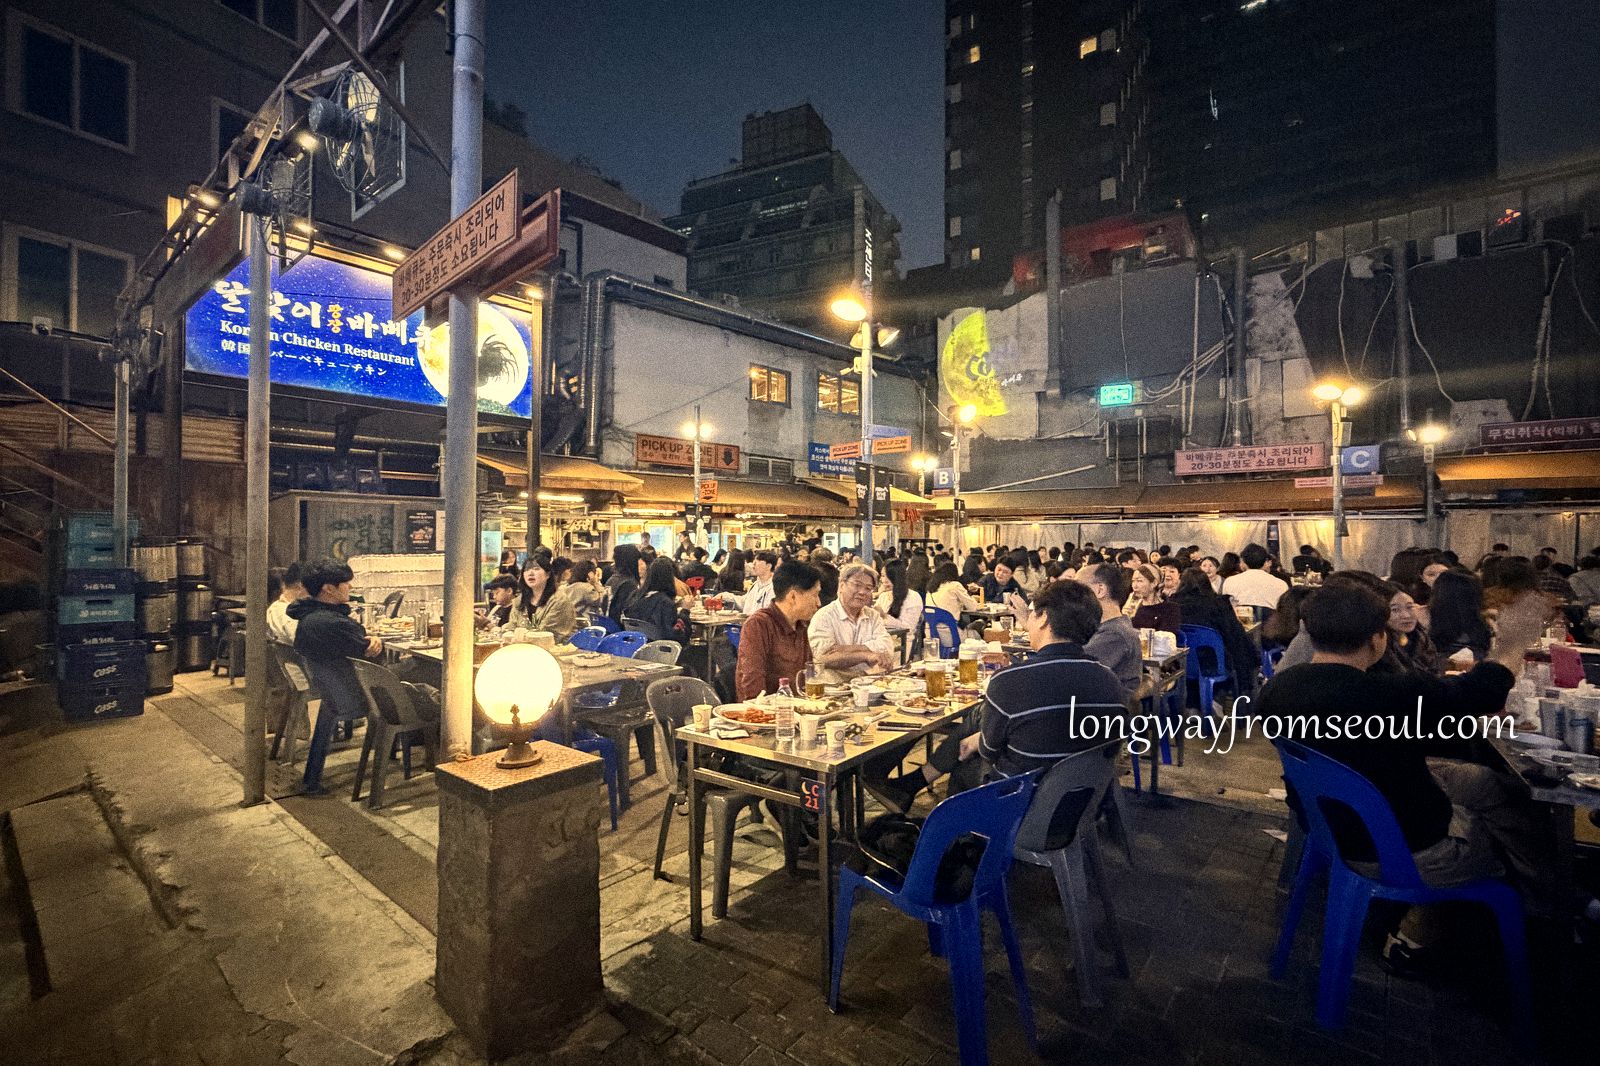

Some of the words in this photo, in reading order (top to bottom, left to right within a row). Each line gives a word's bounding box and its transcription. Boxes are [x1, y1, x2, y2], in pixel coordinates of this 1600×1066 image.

[465, 189, 505, 237] 조리되어
[451, 219, 499, 269] 소요됩니다
[220, 319, 279, 341] Korn
[283, 331, 341, 353] Chicken
[344, 343, 415, 367] Restaurant
[641, 439, 668, 453] PICK
[669, 443, 683, 453] UP
[686, 445, 713, 457] ZNE
[1271, 446, 1313, 457] 조리되어
[1255, 456, 1308, 468] 소요됩니다
[1350, 449, 1370, 468] C
[938, 470, 949, 485] B
[811, 784, 820, 798] C
[804, 795, 820, 810] 21
